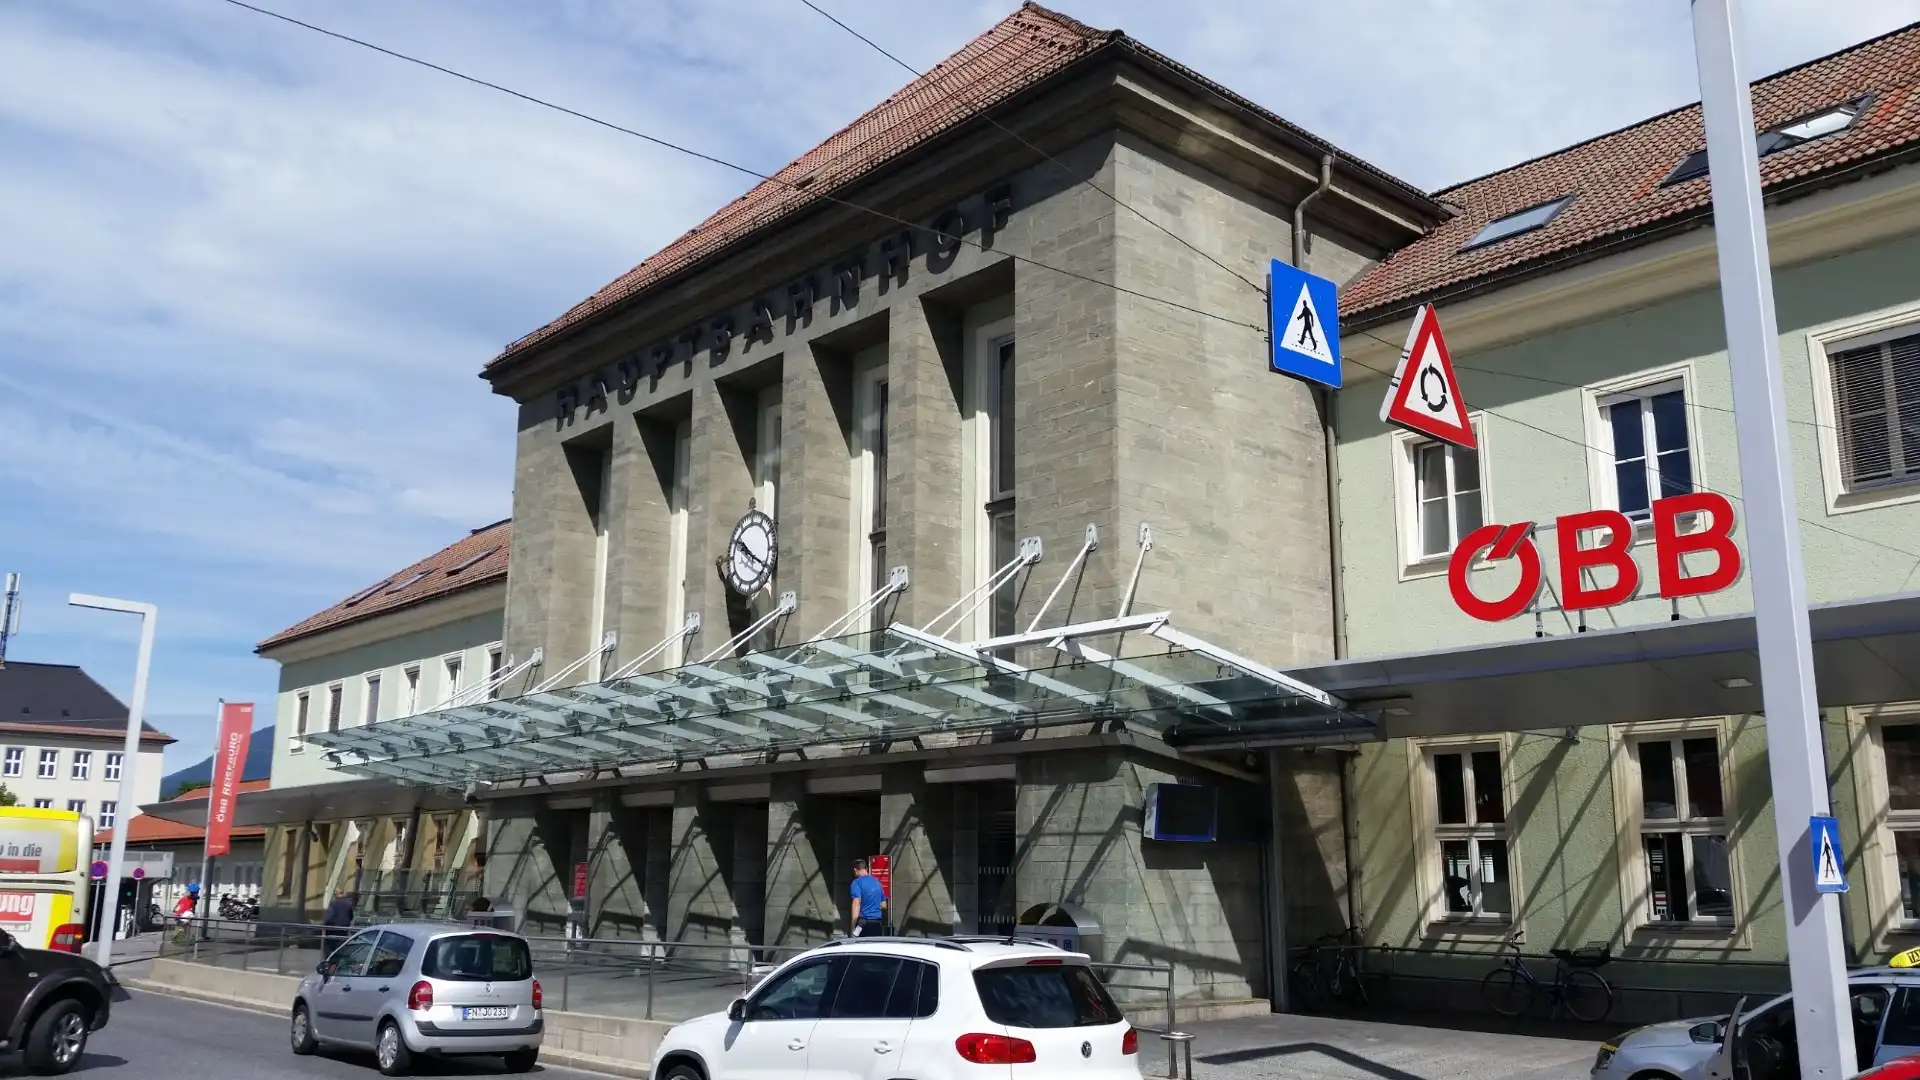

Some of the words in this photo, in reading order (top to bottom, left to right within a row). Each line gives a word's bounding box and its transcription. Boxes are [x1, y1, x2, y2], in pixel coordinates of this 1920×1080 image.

[556, 183, 1012, 431] HAUPTBAHNHOF
[1448, 492, 1743, 622] ÖBB
[7, 842, 19, 857] in
[23, 843, 42, 857] die
